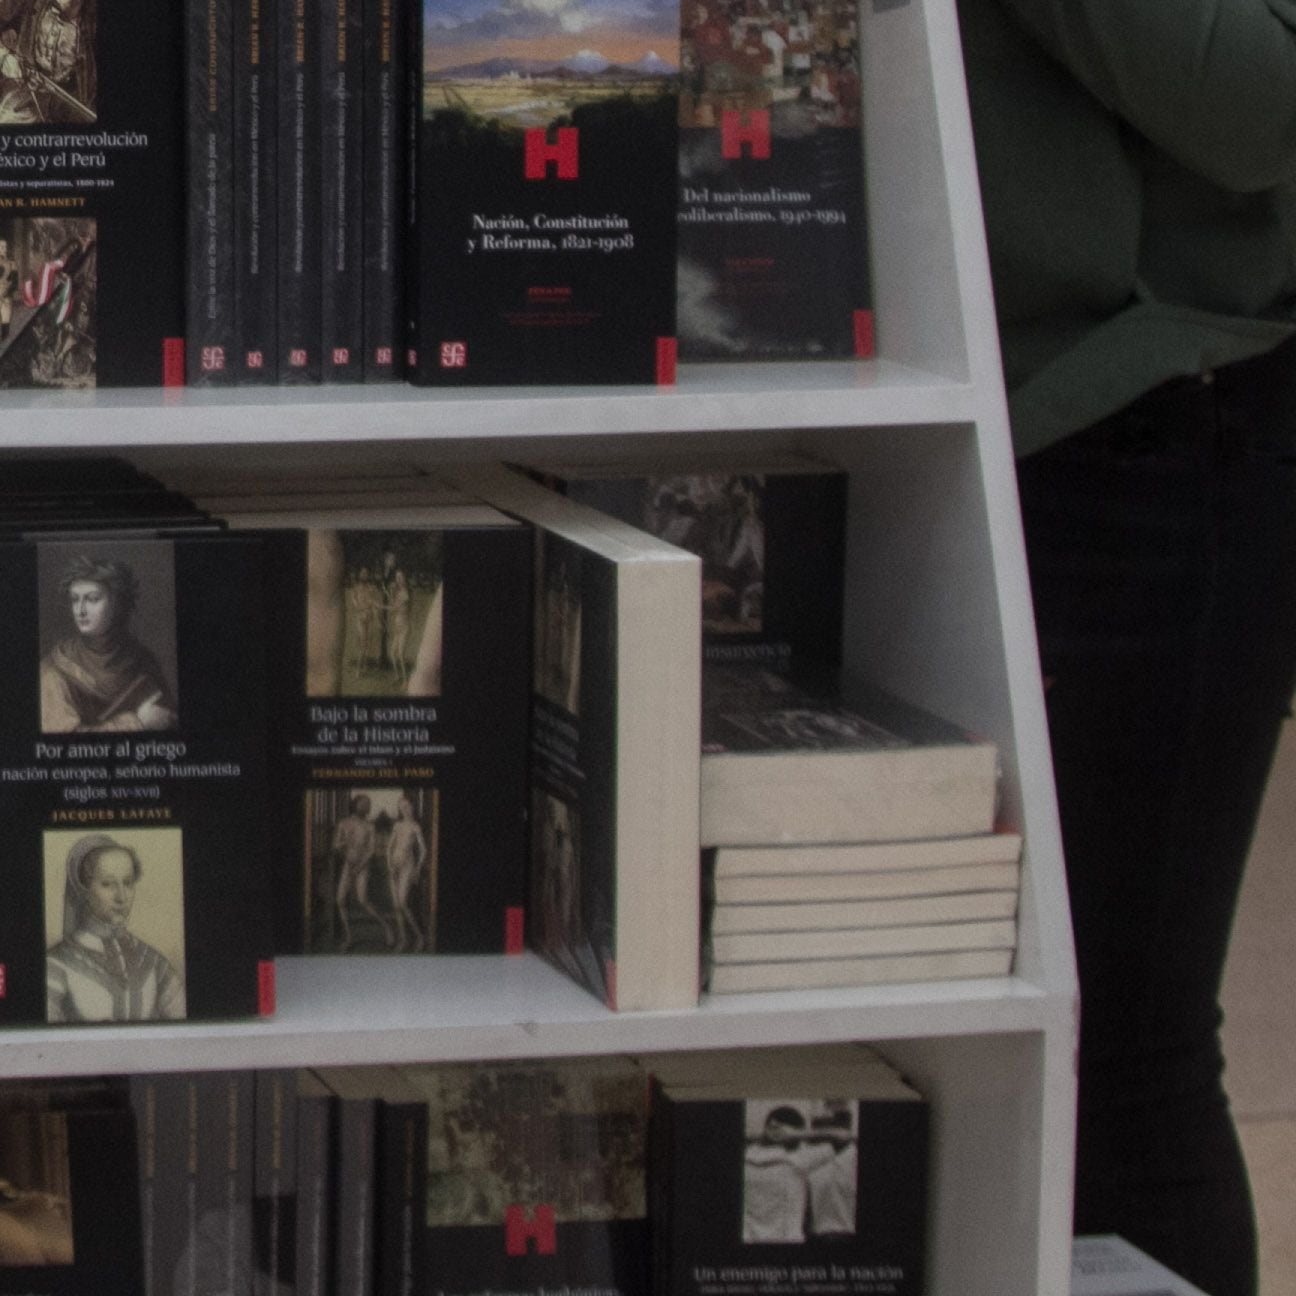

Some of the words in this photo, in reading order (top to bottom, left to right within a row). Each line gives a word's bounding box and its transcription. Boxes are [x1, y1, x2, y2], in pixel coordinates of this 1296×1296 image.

[0, 136, 11, 151] y
[14, 131, 148, 148] contrarrevolución
[39, 155, 50, 171] y
[52, 151, 67, 167] el
[70, 151, 106, 167] Perú
[684, 187, 709, 203] Del
[713, 186, 812, 203] nacionalismo
[473, 213, 530, 232] Nación,
[533, 212, 629, 229] Constitución
[467, 237, 476, 255] y
[482, 233, 557, 251] Reforma,
[310, 704, 348, 724] Bajo
[352, 704, 368, 722] la
[373, 704, 437, 722] sombra
[317, 725, 338, 743] de
[343, 726, 358, 742] la
[363, 726, 430, 742] Historia
[35, 742, 63, 759] Por
[67, 743, 110, 759] amor
[115, 740, 130, 758] al
[135, 741, 187, 762] griego
[2, 766, 49, 781] nación
[169, 763, 241, 779] humanista
[63, 785, 108, 803] (siglos
[52, 809, 115, 822] JACQUES
[121, 808, 172, 819] LAFAYE
[693, 1265, 717, 1283] Un
[720, 1265, 788, 1284] enemigo
[790, 1265, 827, 1284] para
[830, 1263, 846, 1282] la
[849, 1263, 904, 1282] nación
